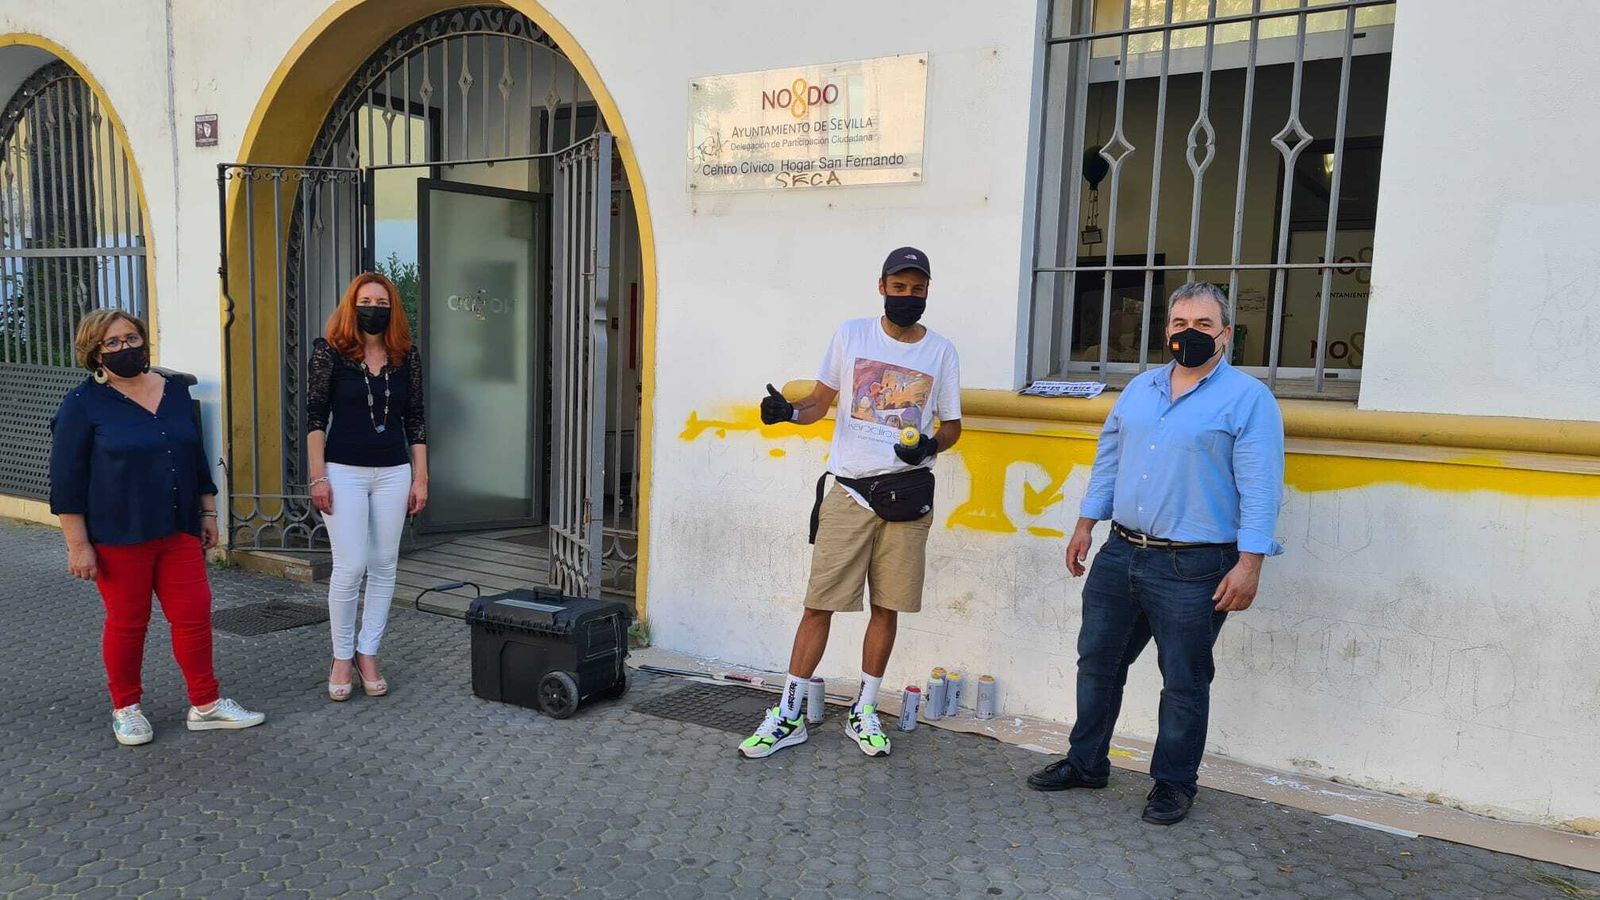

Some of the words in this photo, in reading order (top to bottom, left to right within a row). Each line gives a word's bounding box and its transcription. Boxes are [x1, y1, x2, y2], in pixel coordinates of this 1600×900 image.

[731, 122, 811, 138] AYUNTAMIENTO
[814, 120, 828, 132] DE
[830, 117, 873, 131] SEVILLA
[730, 139, 770, 152] Delegación
[771, 138, 781, 148] de
[782, 134, 829, 148] Participación
[832, 132, 873, 144] Ciudadana
[702, 163, 738, 176] Centro
[740, 160, 775, 174] Cívico
[780, 158, 815, 173] Hogar
[819, 156, 842, 170] San
[845, 152, 904, 167] Fernando
[775, 170, 842, 188] SECA
